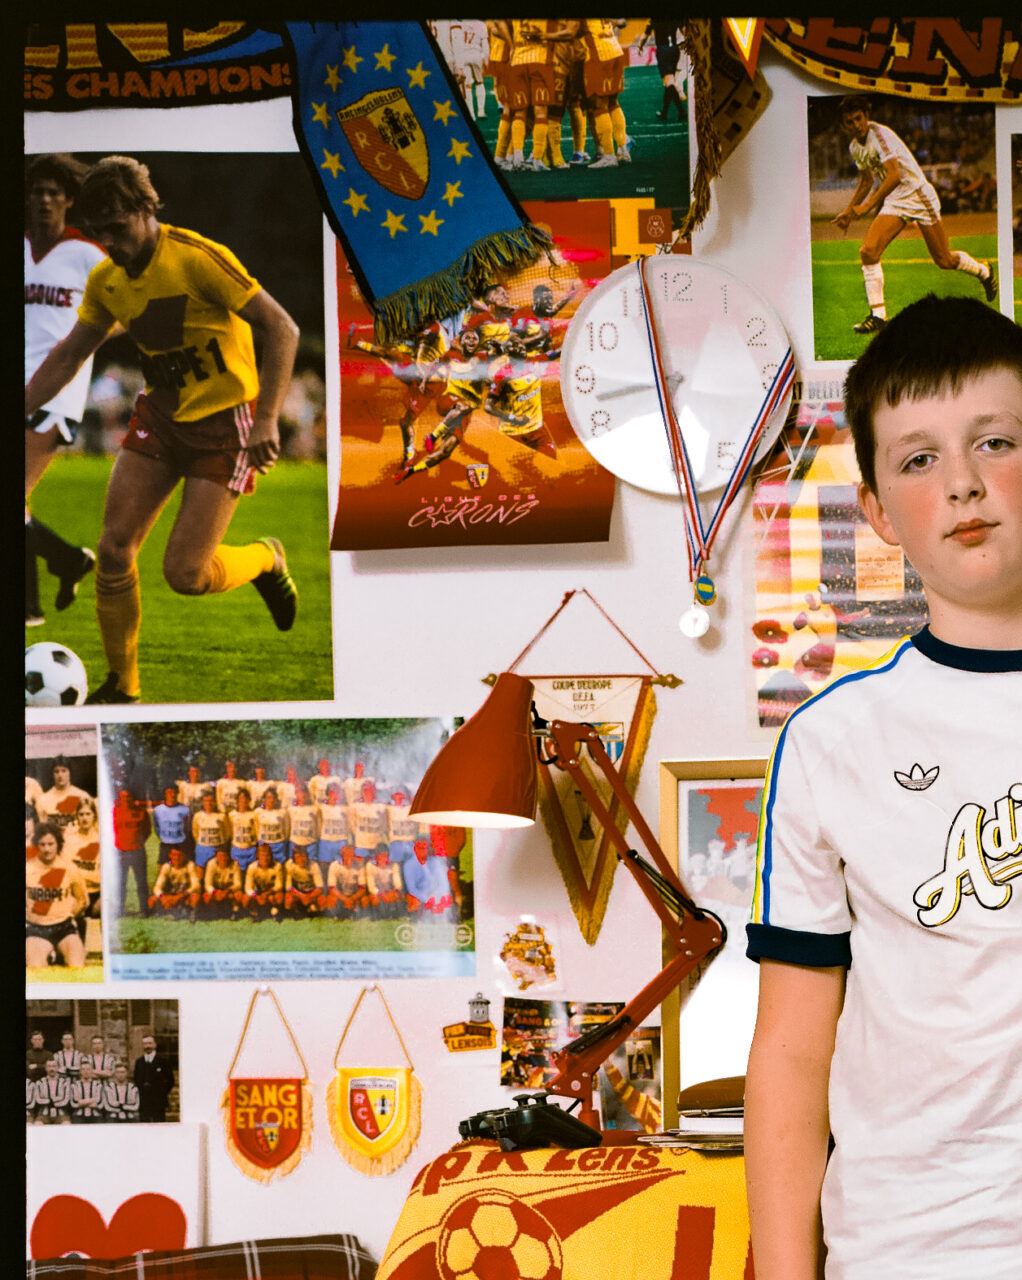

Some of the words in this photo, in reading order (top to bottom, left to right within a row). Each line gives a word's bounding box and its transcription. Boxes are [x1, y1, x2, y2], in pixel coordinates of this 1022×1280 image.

[661, 272, 693, 302] 12
[586, 321, 619, 352] 10
[746, 316, 767, 347] 2
[575, 364, 596, 394] 9
[451, 1038, 493, 1050] LENSOIS
[237, 1084, 297, 1107] SANG
[236, 1108, 257, 1129] ET
[261, 1107, 298, 1129] OR
[354, 1093, 377, 1134] RCL
